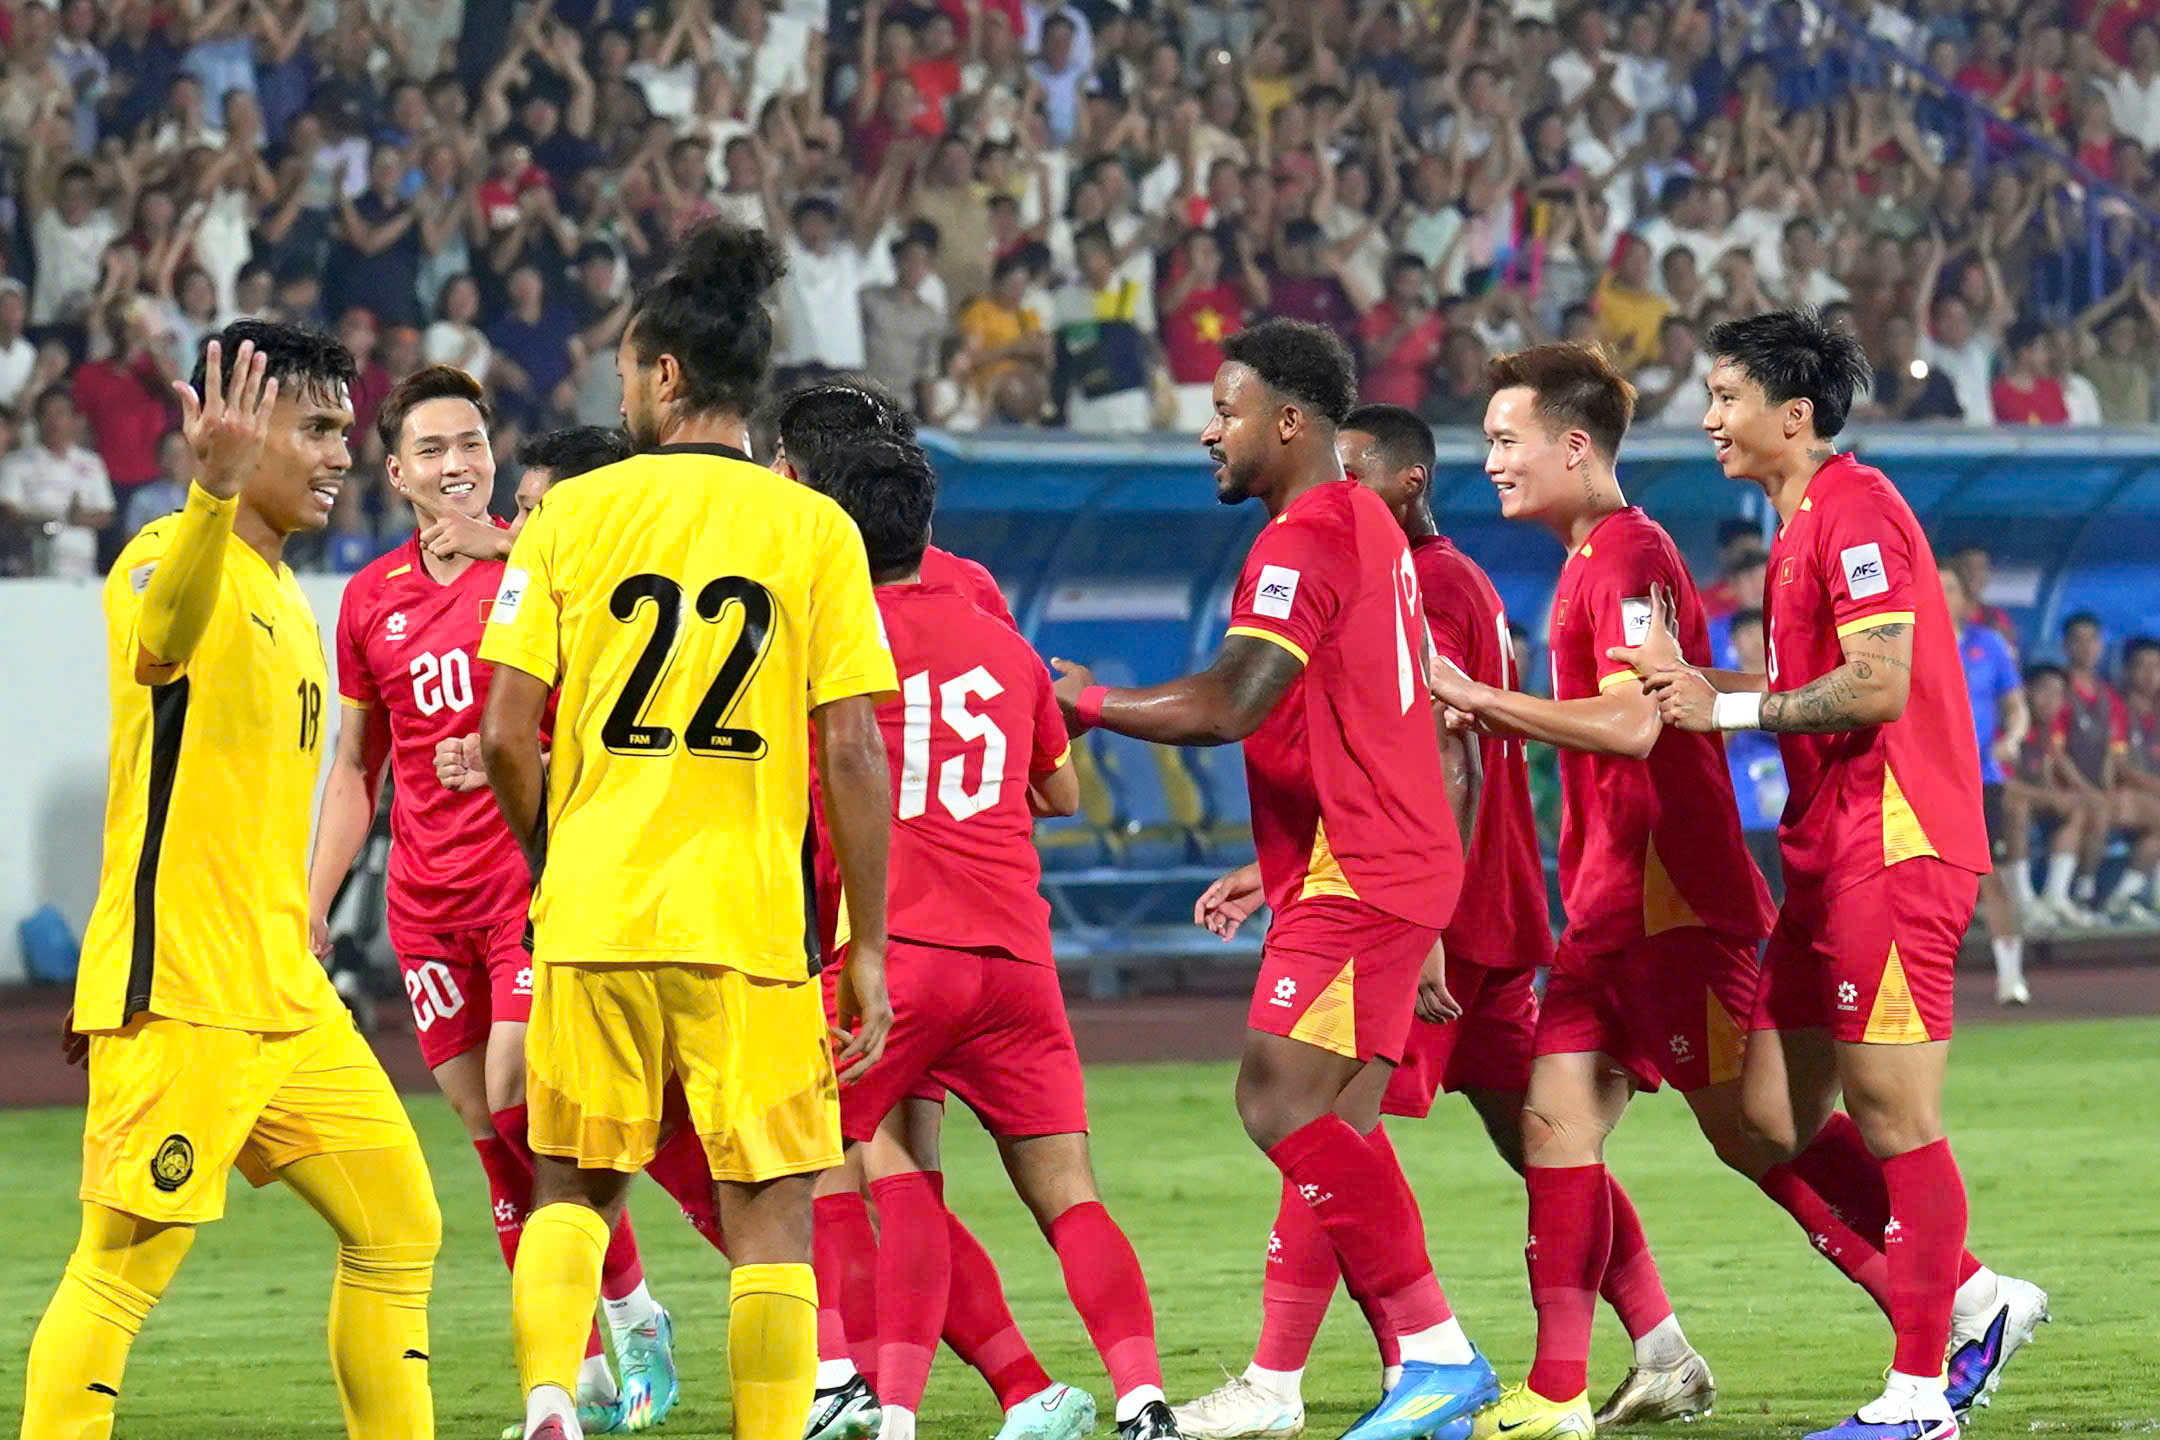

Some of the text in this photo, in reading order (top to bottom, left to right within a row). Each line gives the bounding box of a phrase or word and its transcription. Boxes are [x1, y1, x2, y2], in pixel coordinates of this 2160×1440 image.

[1262, 583, 1293, 598] AFC
[1852, 561, 1880, 579] AFC
[410, 647, 474, 717] 20
[601, 573, 777, 761] 22
[297, 677, 321, 756] 18
[629, 734, 650, 745] FAM
[711, 735, 732, 747] FAM
[899, 665, 1007, 822] 15
[405, 960, 465, 1033] 20
